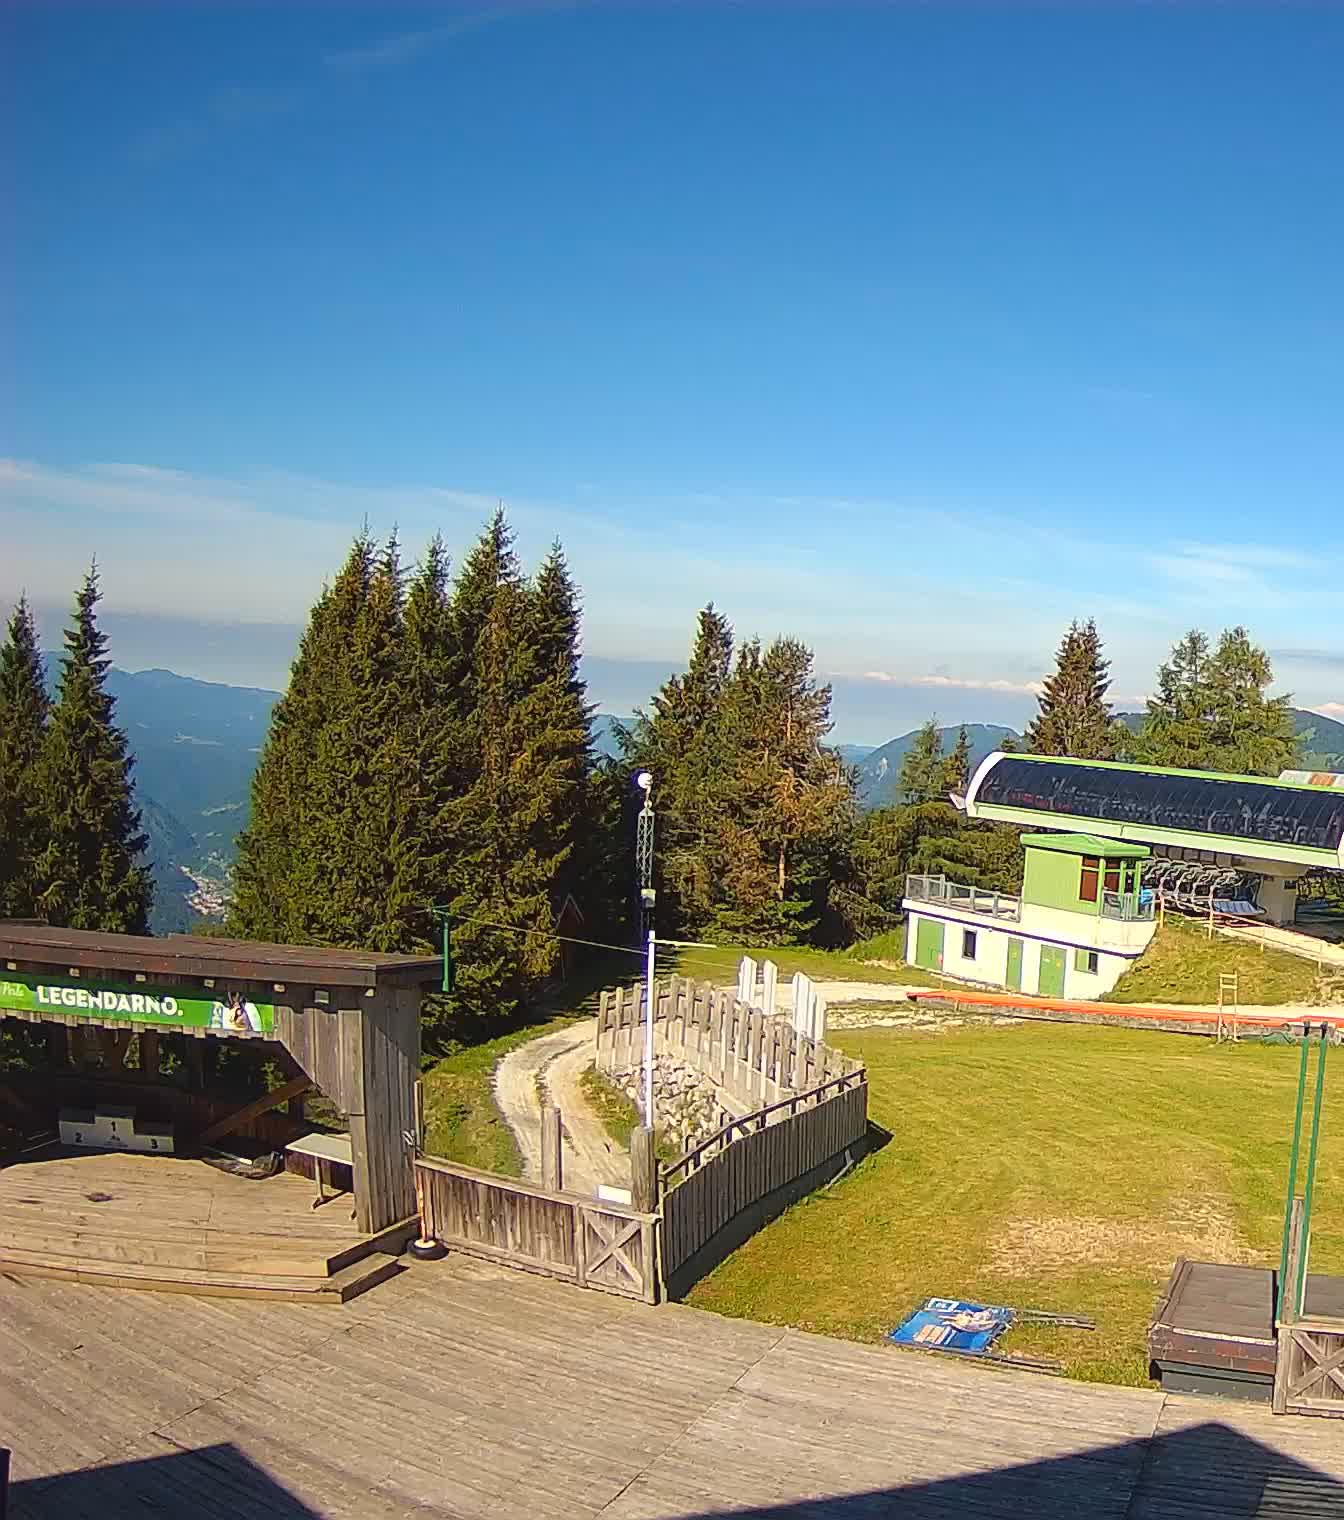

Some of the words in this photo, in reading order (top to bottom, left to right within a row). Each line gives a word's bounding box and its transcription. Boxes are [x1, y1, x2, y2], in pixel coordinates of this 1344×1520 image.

[36, 985, 184, 1017] LEGENDARNO.
[111, 1121, 117, 1132] 1
[75, 1132, 83, 1143] 2
[150, 1138, 158, 1149] 3
